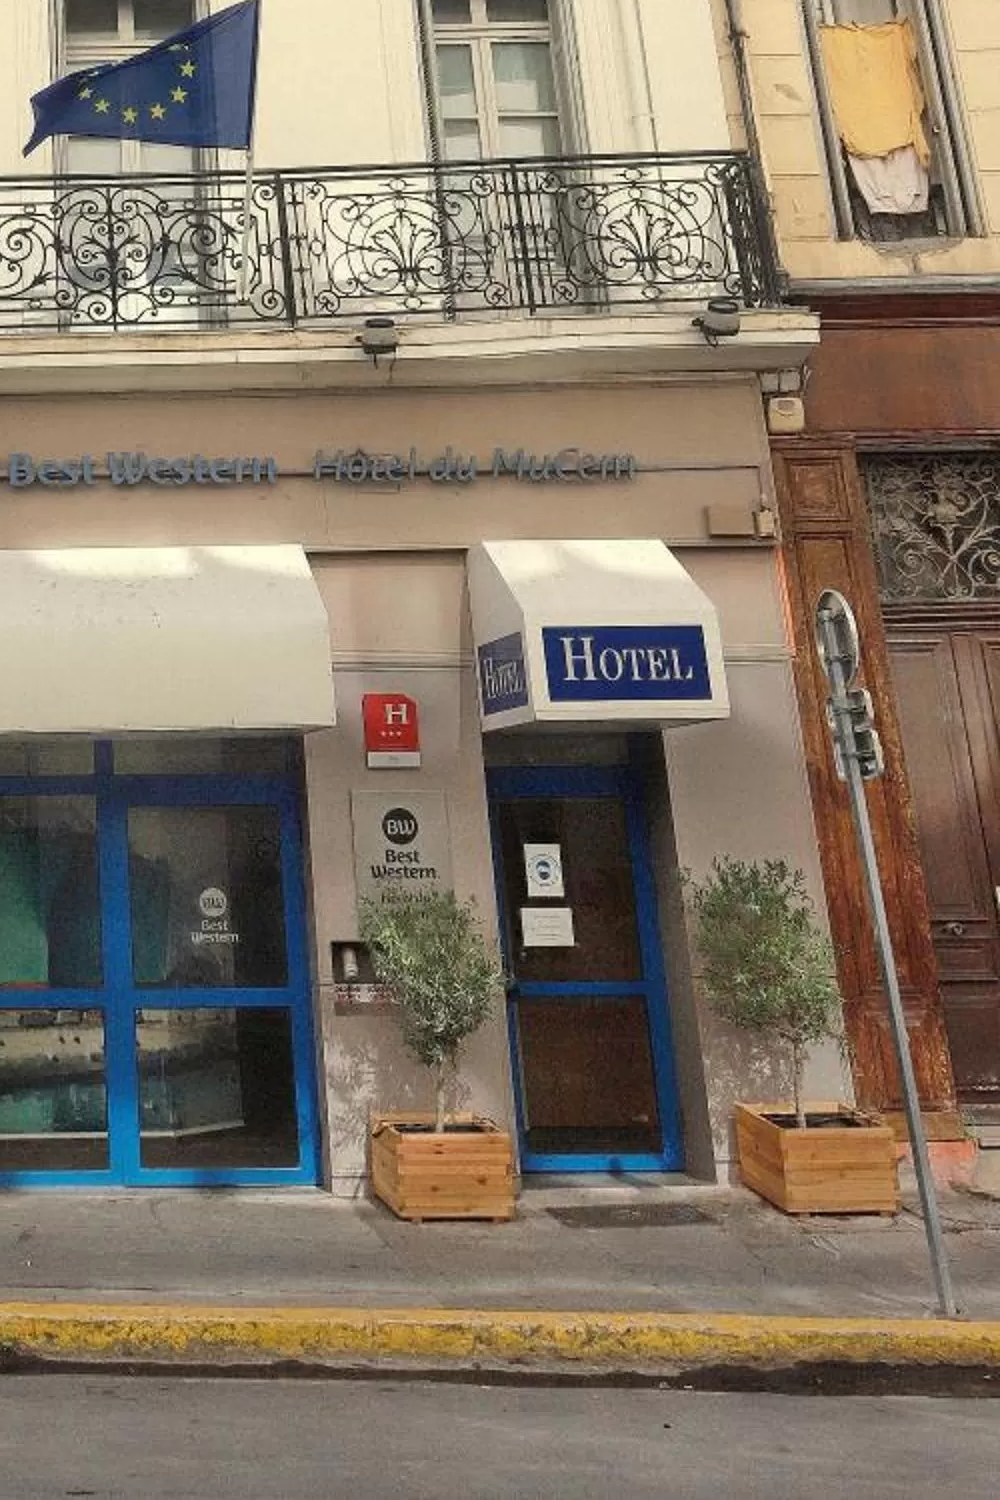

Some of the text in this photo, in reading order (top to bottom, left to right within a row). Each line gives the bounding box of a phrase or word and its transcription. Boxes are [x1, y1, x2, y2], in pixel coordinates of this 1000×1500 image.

[8, 452, 97, 487] Best
[106, 451, 277, 486] Western
[429, 445, 477, 482] du
[385, 703, 409, 726] H
[386, 820, 416, 836] BW
[385, 849, 421, 864] Best
[369, 864, 437, 880] Western
[201, 920, 229, 931] Best
[190, 931, 239, 943] Western
